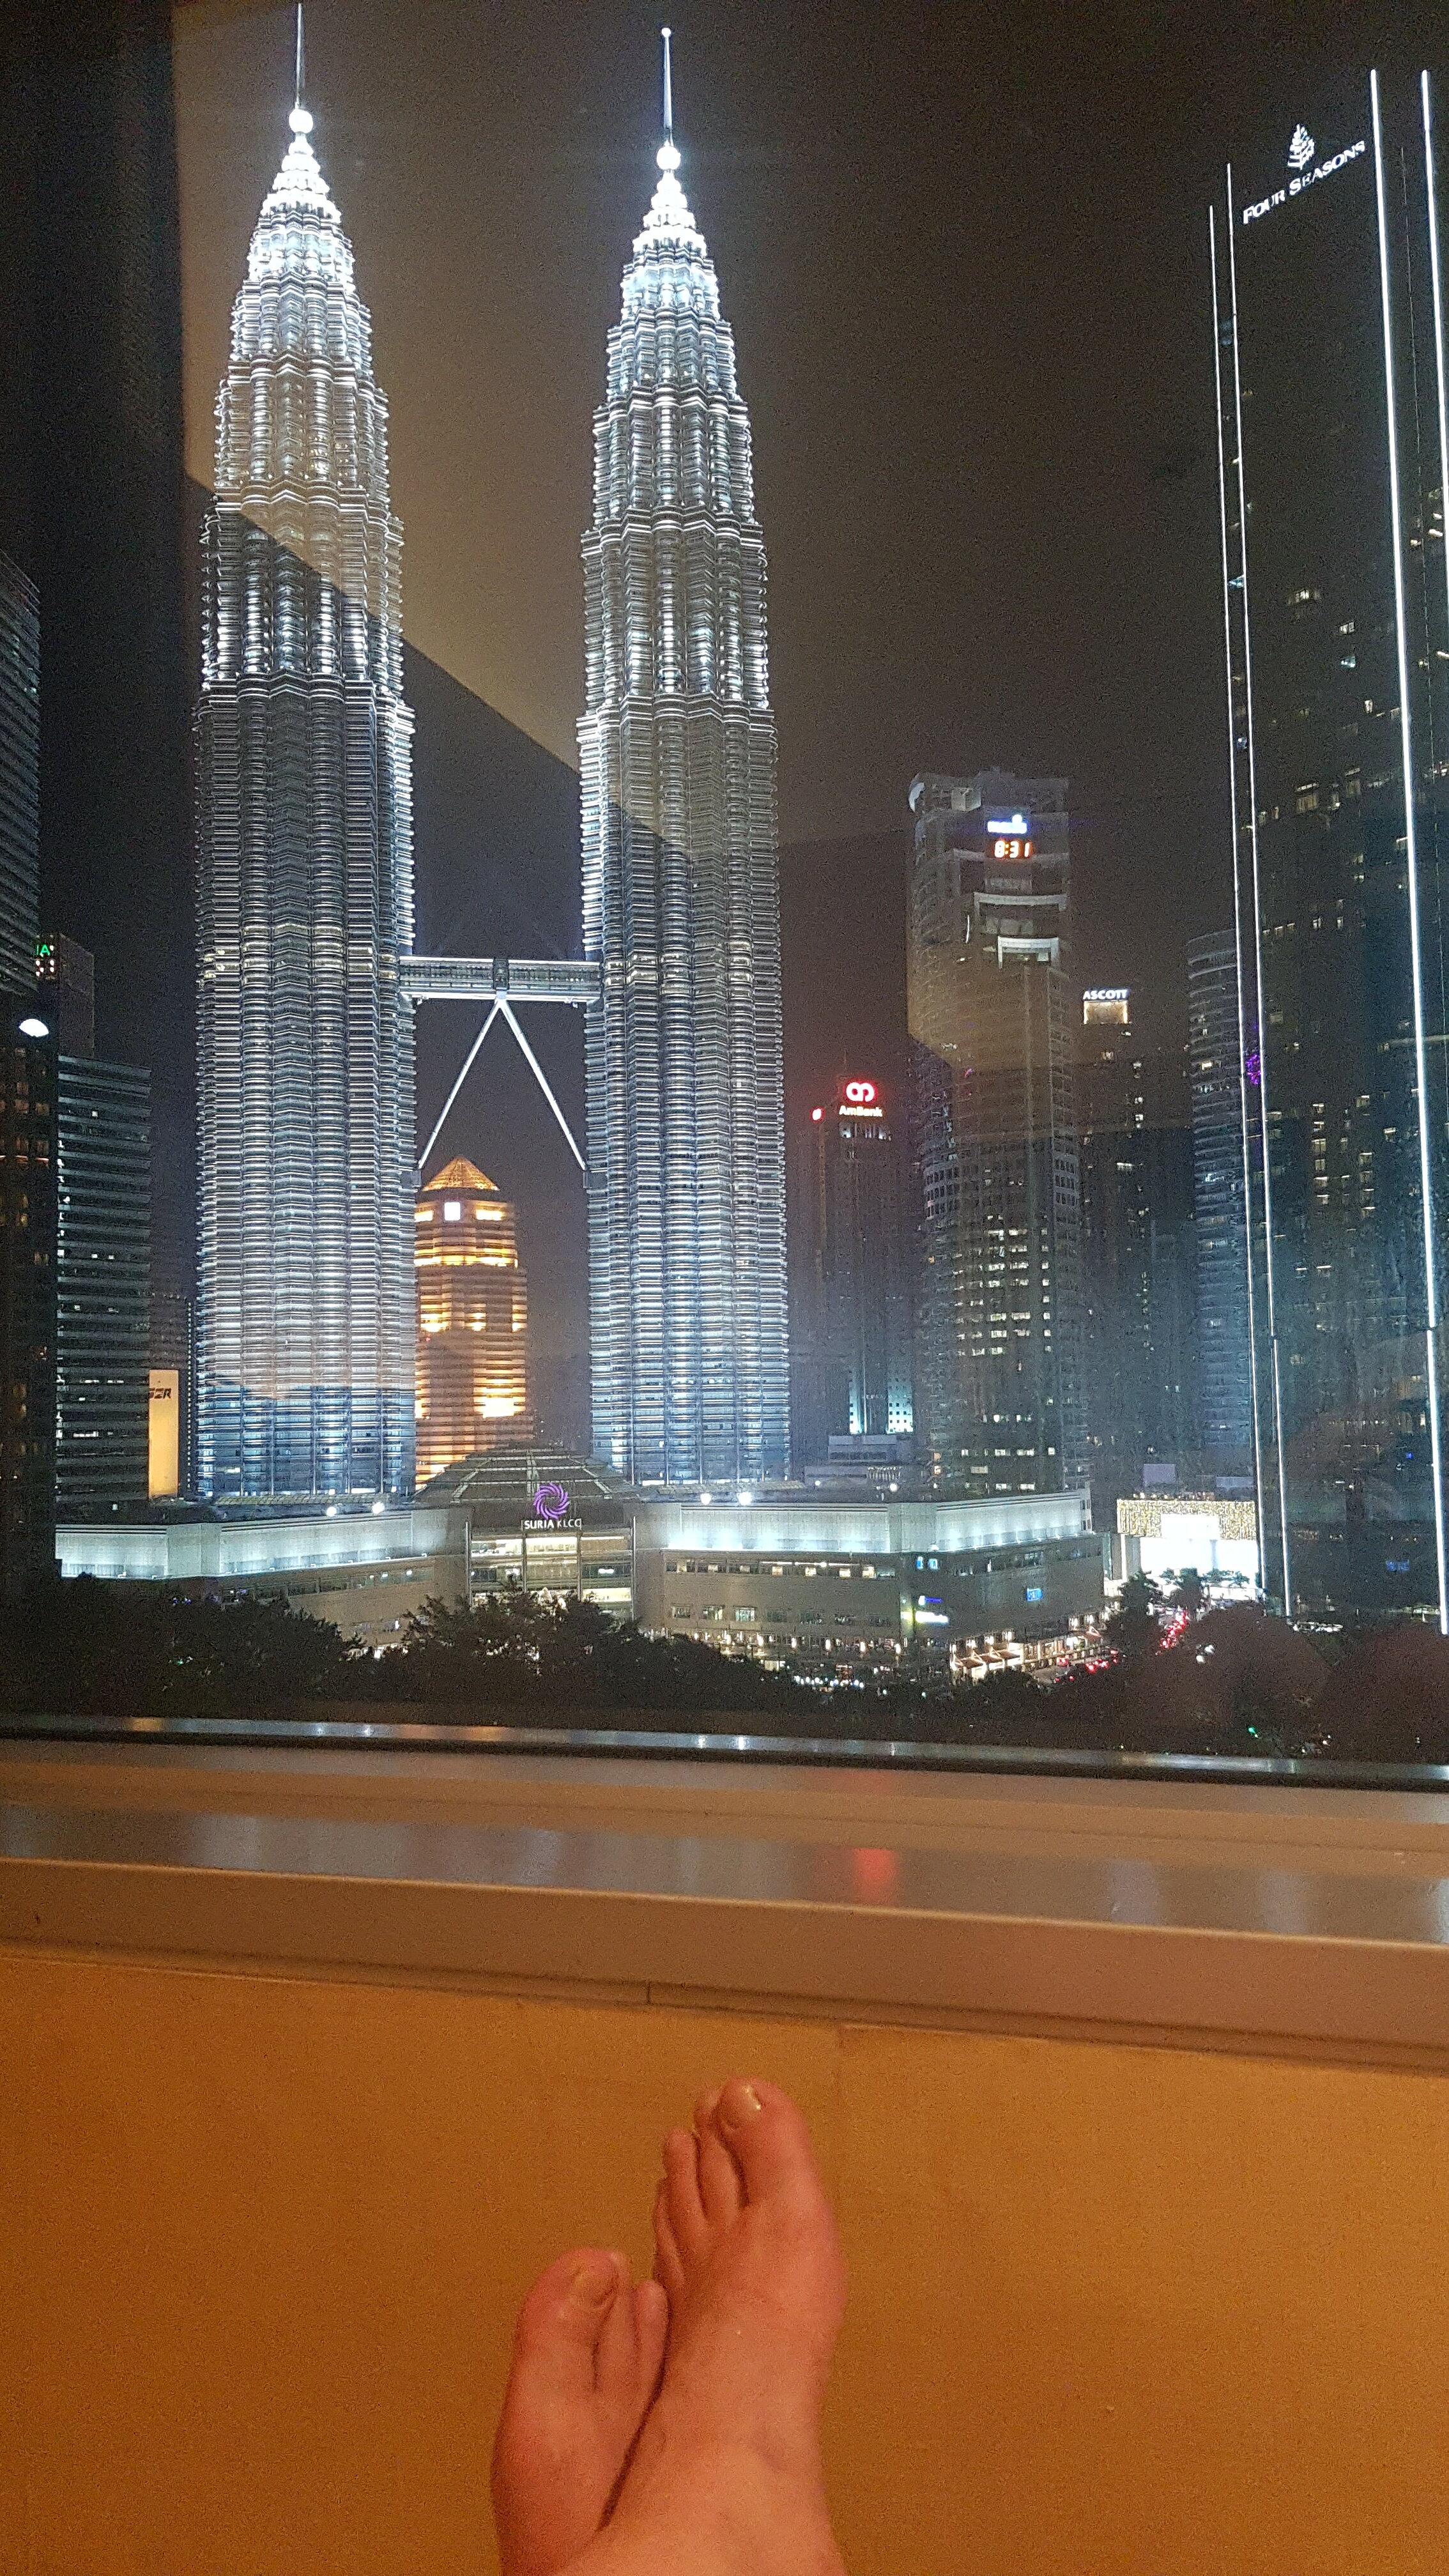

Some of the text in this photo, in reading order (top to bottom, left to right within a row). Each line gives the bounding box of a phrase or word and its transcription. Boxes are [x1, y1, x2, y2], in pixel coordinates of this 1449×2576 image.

[1243, 140, 1365, 224] FOUR SEASONS
[994, 840, 1030, 858] 8:31
[1082, 989, 1128, 1000] ASCOTT
[838, 1105, 883, 1117] AmBank
[524, 1518, 582, 1529] SURIA KLCC
